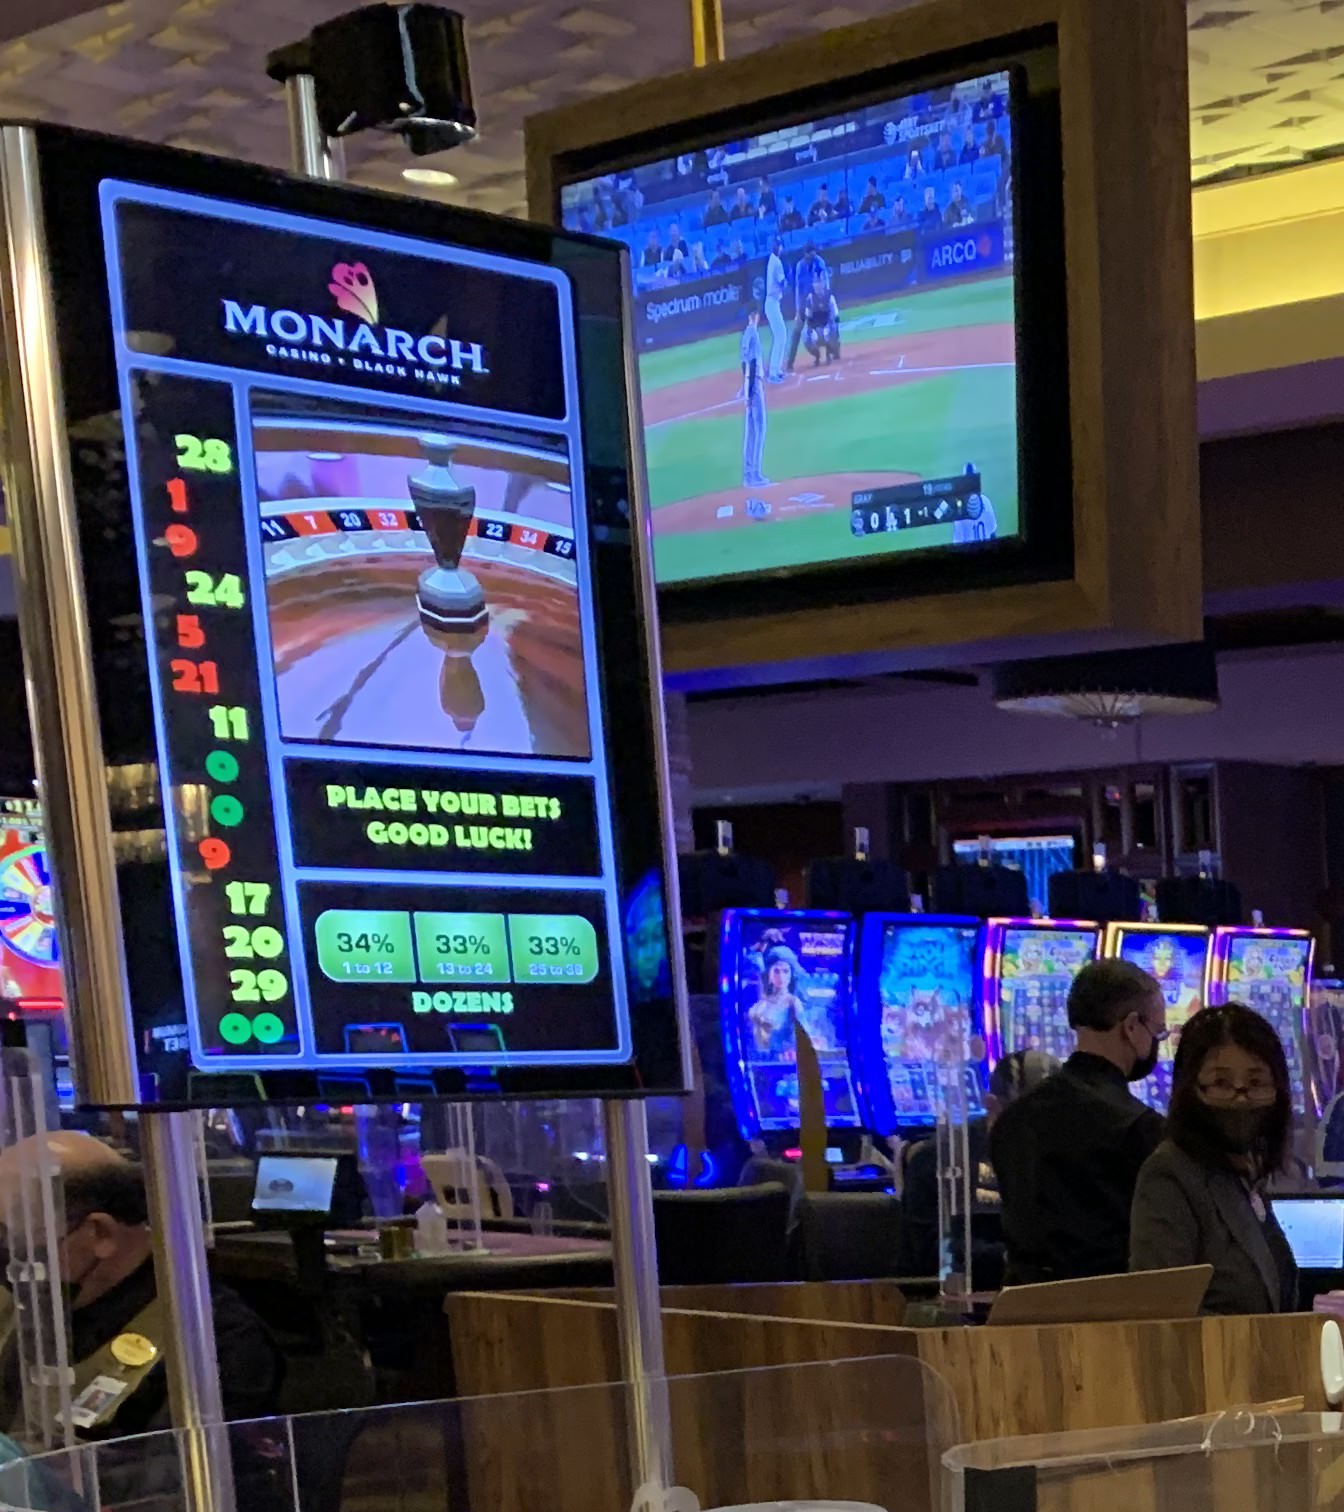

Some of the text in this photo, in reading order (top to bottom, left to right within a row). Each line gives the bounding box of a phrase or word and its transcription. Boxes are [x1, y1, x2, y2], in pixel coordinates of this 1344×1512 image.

[931, 239, 978, 268] ARCO
[646, 295, 700, 324] Spectrum
[221, 299, 487, 373] MONARCH
[266, 344, 461, 386] CASINO BLACK HAWK
[175, 433, 233, 474] 28
[168, 480, 188, 511] 1
[167, 525, 197, 558] 9
[186, 572, 244, 609] 24
[177, 615, 205, 648] 5
[171, 660, 219, 694] 21
[209, 705, 249, 740] 11
[205, 750, 240, 783] 0
[211, 794, 244, 827] 0
[326, 784, 562, 820] PLACE YOUR BETS
[367, 821, 532, 851] GOOD LUCK!
[199, 839, 231, 870] 9
[225, 881, 271, 915] 17
[223, 926, 283, 959] 20
[336, 932, 395, 956] 34%
[435, 934, 490, 957] 33%
[528, 936, 581, 958] 33%
[230, 969, 288, 1003] 29
[412, 991, 514, 1014] DOZENS
[219, 1013, 284, 1044] 00
